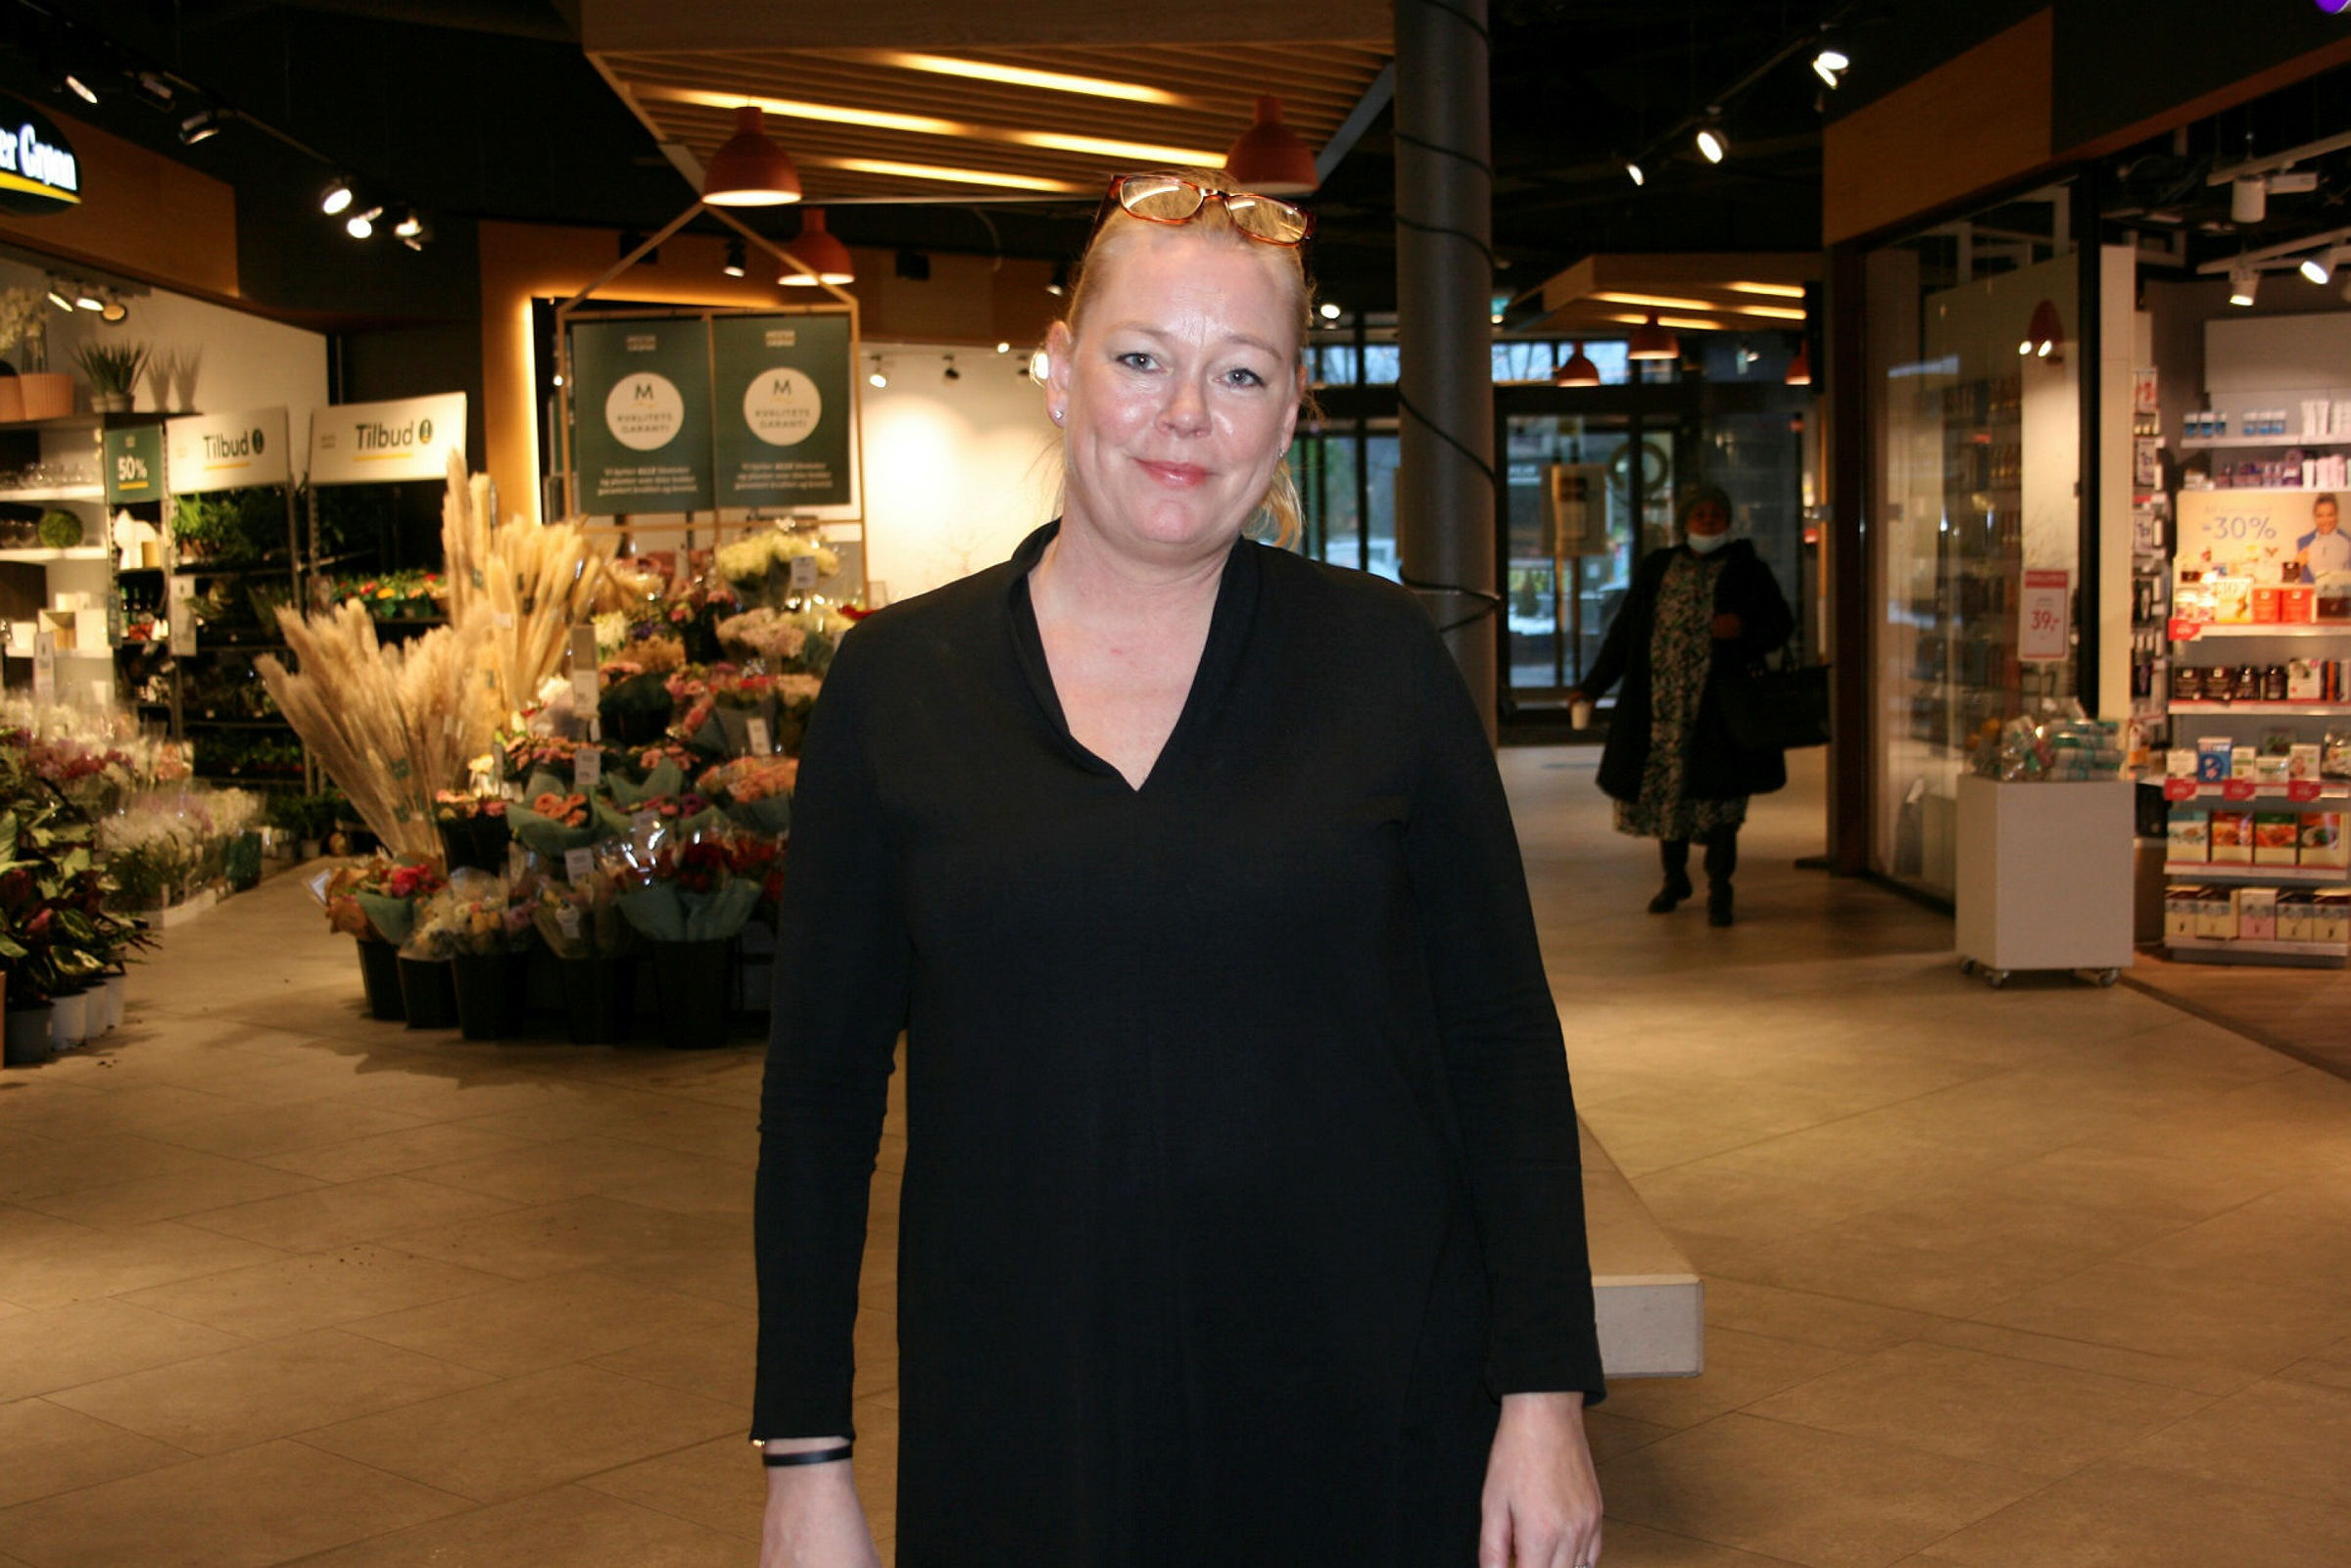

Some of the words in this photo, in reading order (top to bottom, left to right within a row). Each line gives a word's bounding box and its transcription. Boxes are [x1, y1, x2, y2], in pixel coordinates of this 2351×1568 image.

[634, 383, 654, 401] M
[773, 379, 792, 397] M
[203, 431, 249, 459] Tilbud
[356, 420, 414, 451] Tilbud
[117, 455, 148, 481] 50%
[2201, 516, 2278, 540] -30%
